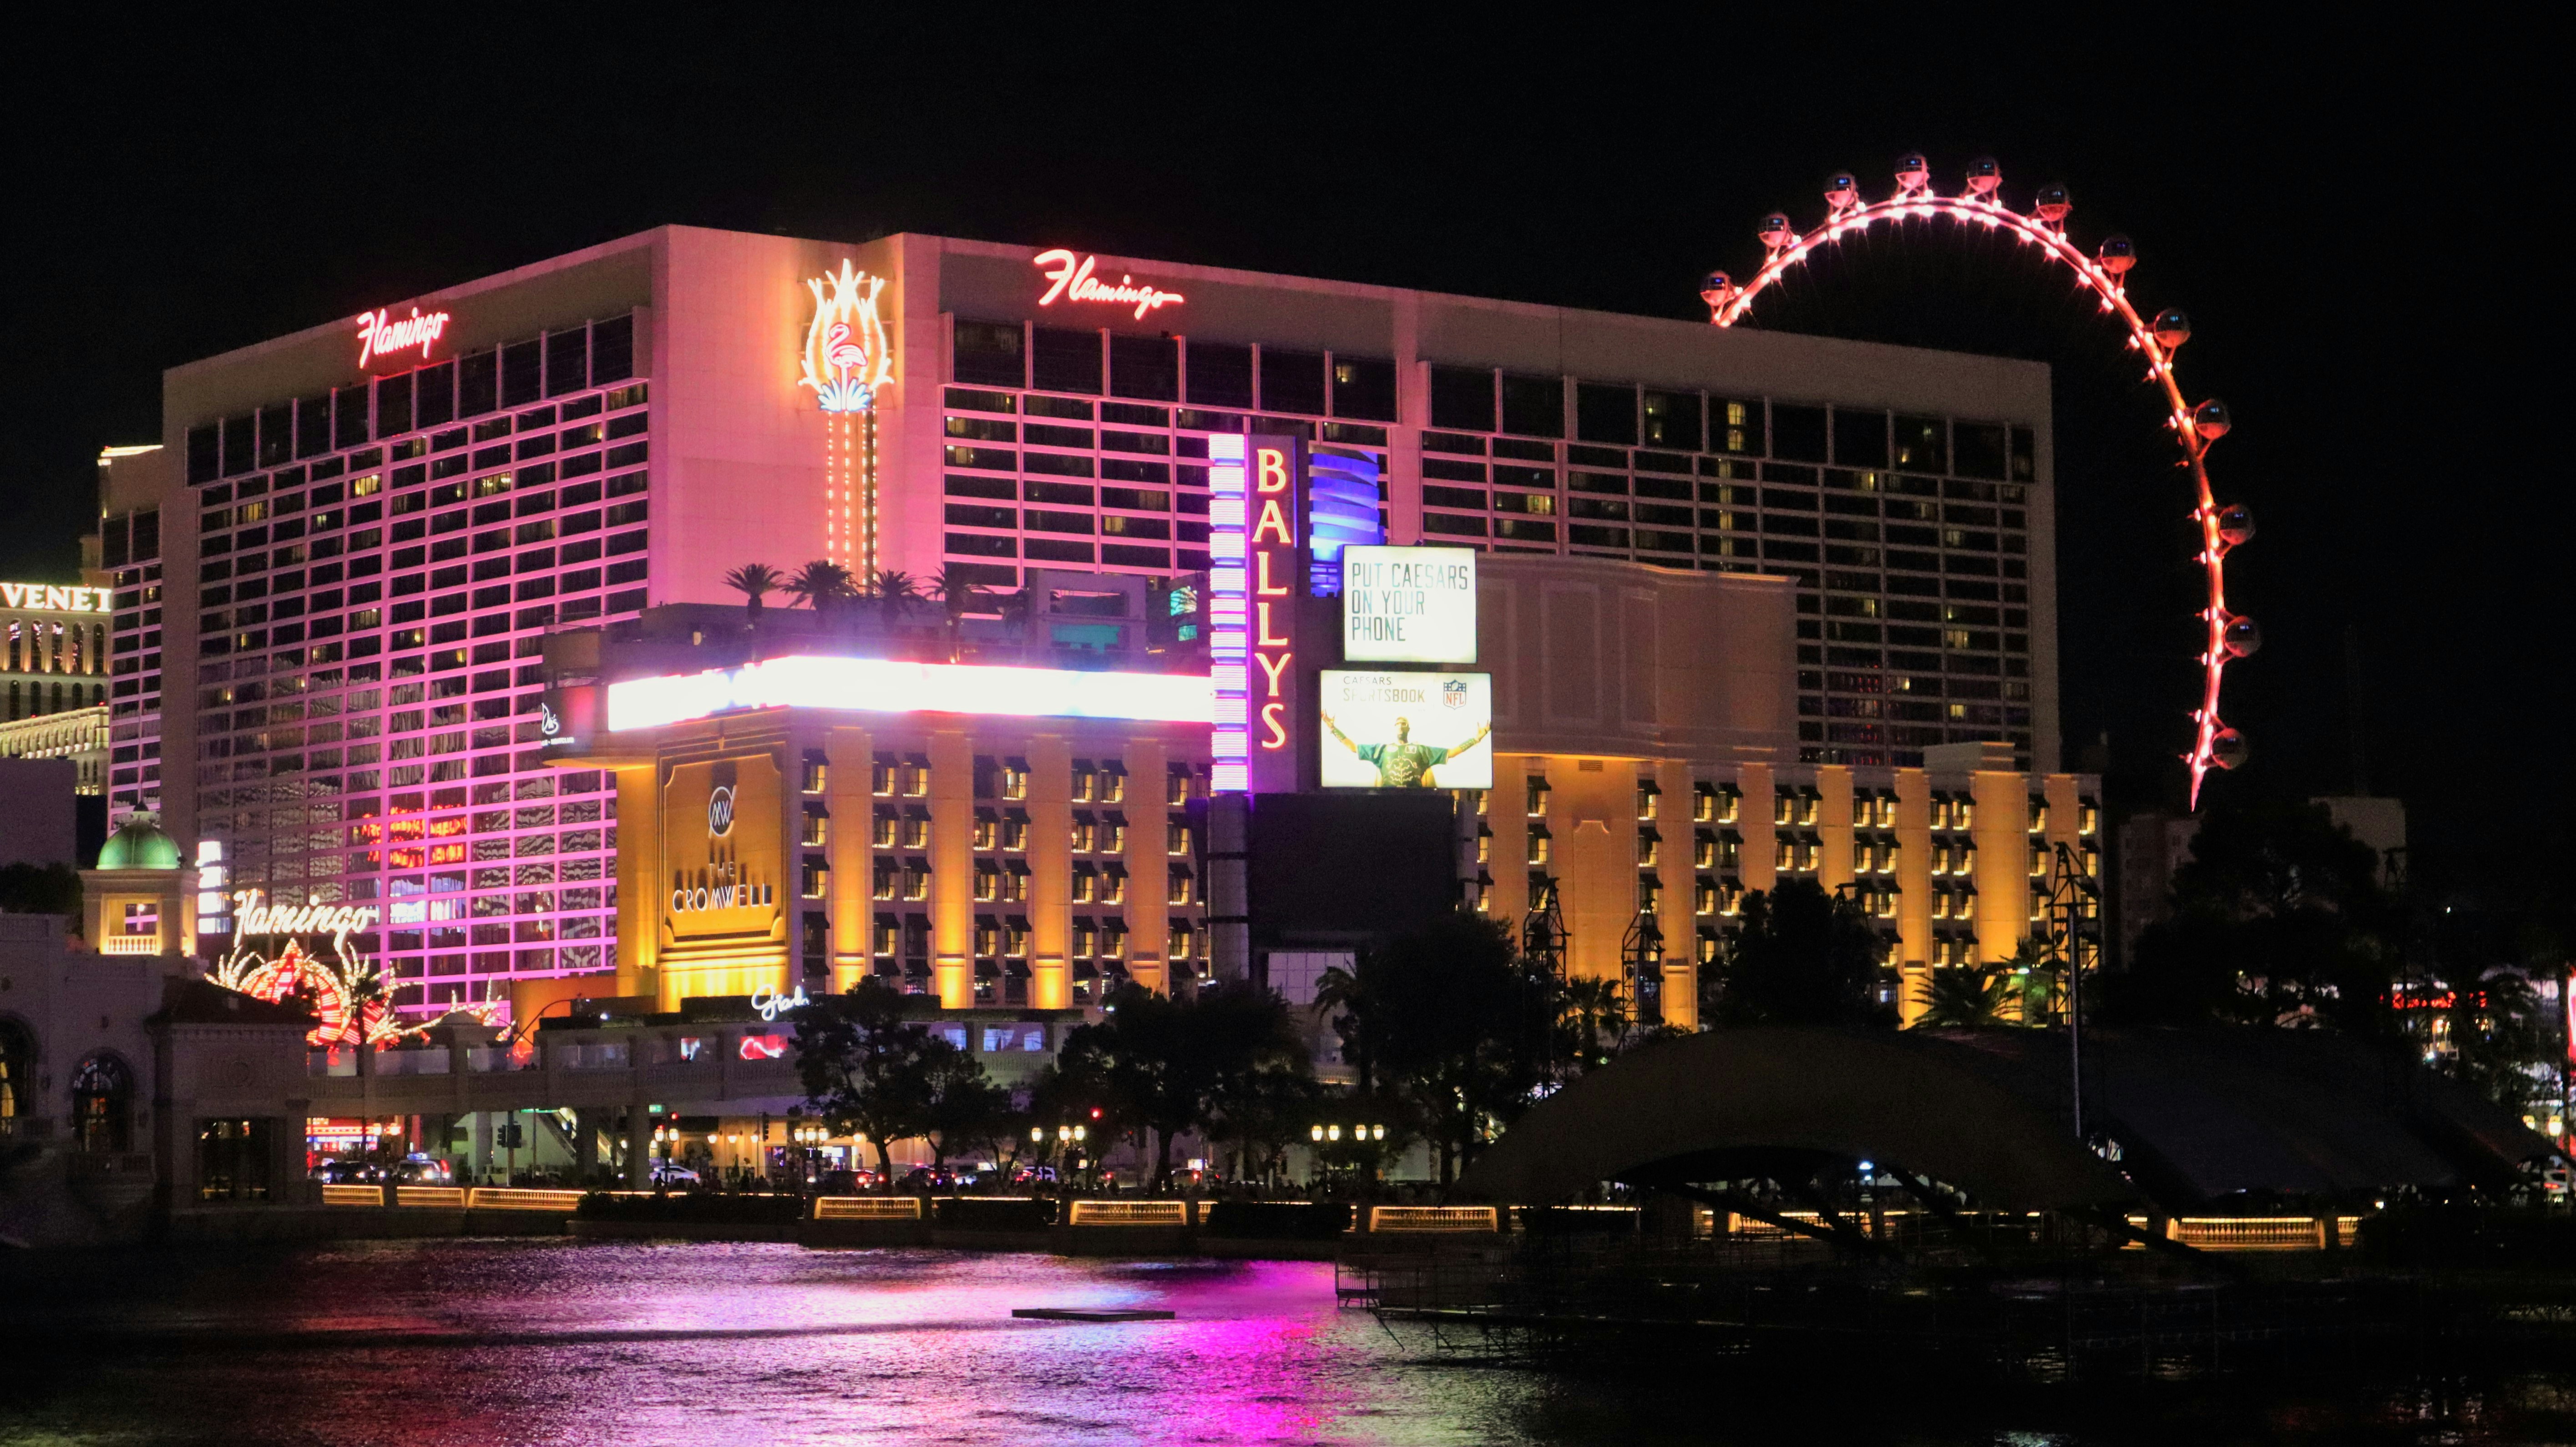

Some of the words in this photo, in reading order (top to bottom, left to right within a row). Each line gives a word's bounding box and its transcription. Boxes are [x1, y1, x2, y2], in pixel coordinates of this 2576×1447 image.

[1034, 249, 1184, 320] Flamingo
[357, 307, 449, 369] Flamingo
[1352, 563, 1383, 587] PUT
[1392, 563, 1468, 590] CAESARS
[1251, 448, 1291, 749] BALLYS
[1351, 589, 1372, 614] ON
[1382, 590, 1424, 615] YOUR
[1352, 616, 1406, 641] PHONE
[1343, 676, 1392, 685] CAESARS
[1446, 692, 1464, 706] NFL
[709, 861, 735, 878] THE
[673, 882, 773, 913] CROMWELL
[233, 888, 380, 958] Flamingo
